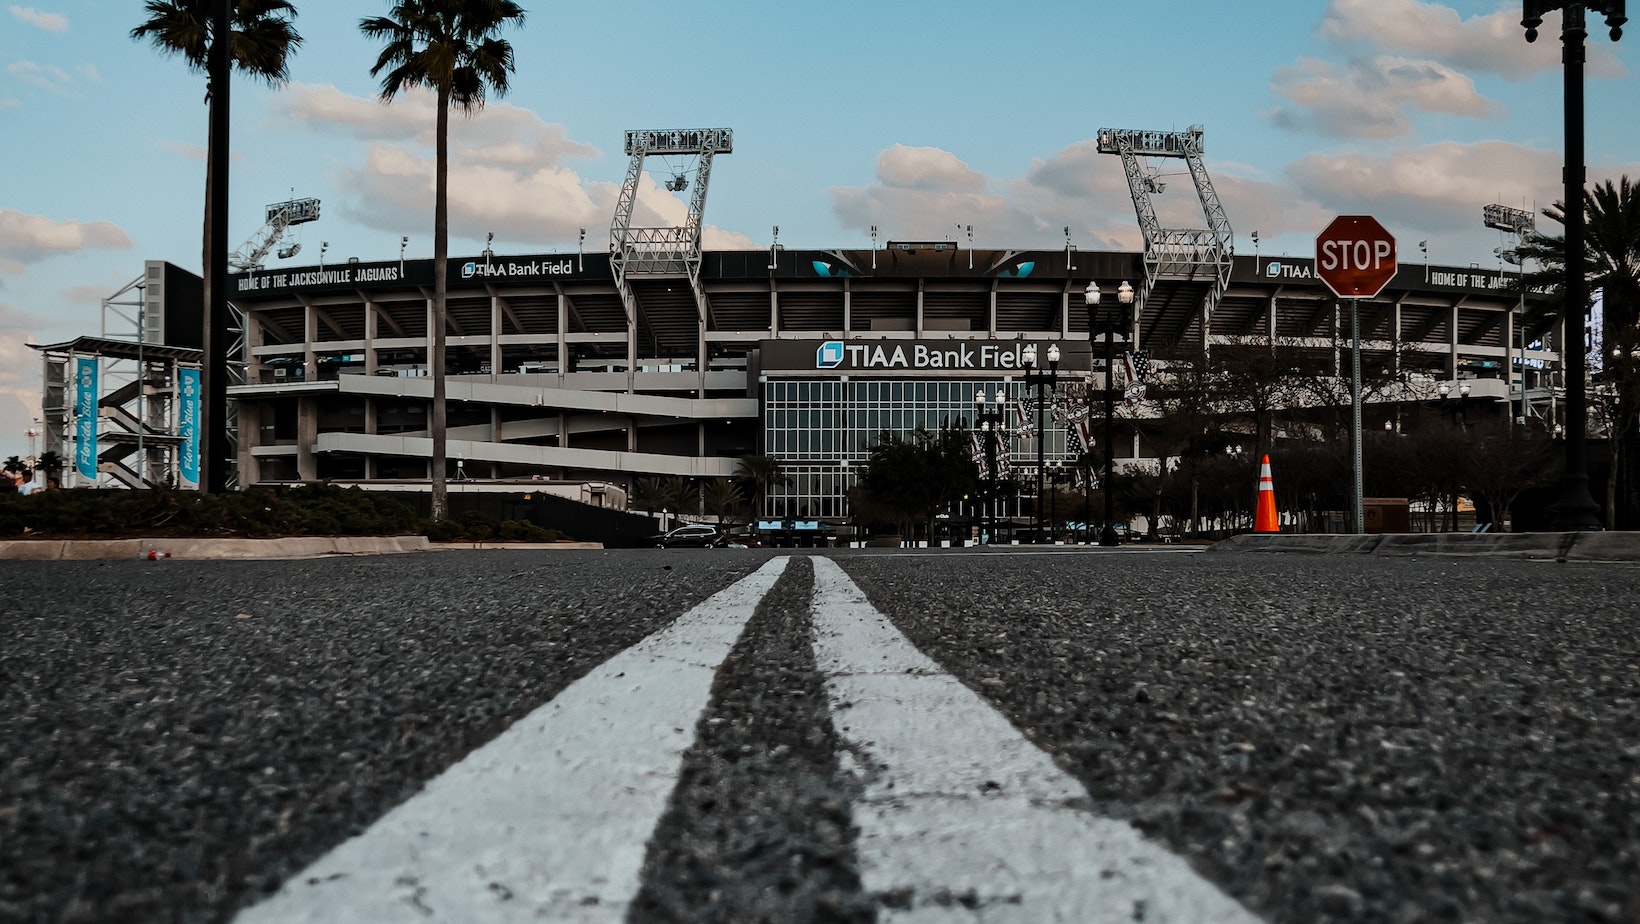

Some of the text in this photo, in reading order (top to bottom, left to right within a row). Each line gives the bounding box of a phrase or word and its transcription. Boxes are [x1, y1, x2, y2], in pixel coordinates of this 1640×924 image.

[1321, 239, 1391, 271] STOP
[238, 267, 398, 291] HOME OF THE JACKSONVILLE JAGUARS
[475, 259, 572, 277] TIAA Bank Field
[1280, 265, 1311, 279] TIAA
[1431, 271, 1456, 286] HOME
[1456, 273, 1468, 287] OF
[1470, 274, 1486, 289] THE
[845, 344, 908, 368] TIAA
[914, 342, 975, 368] Bank
[81, 391, 92, 466] Florida Blue
[184, 399, 194, 470] Florida Blue
